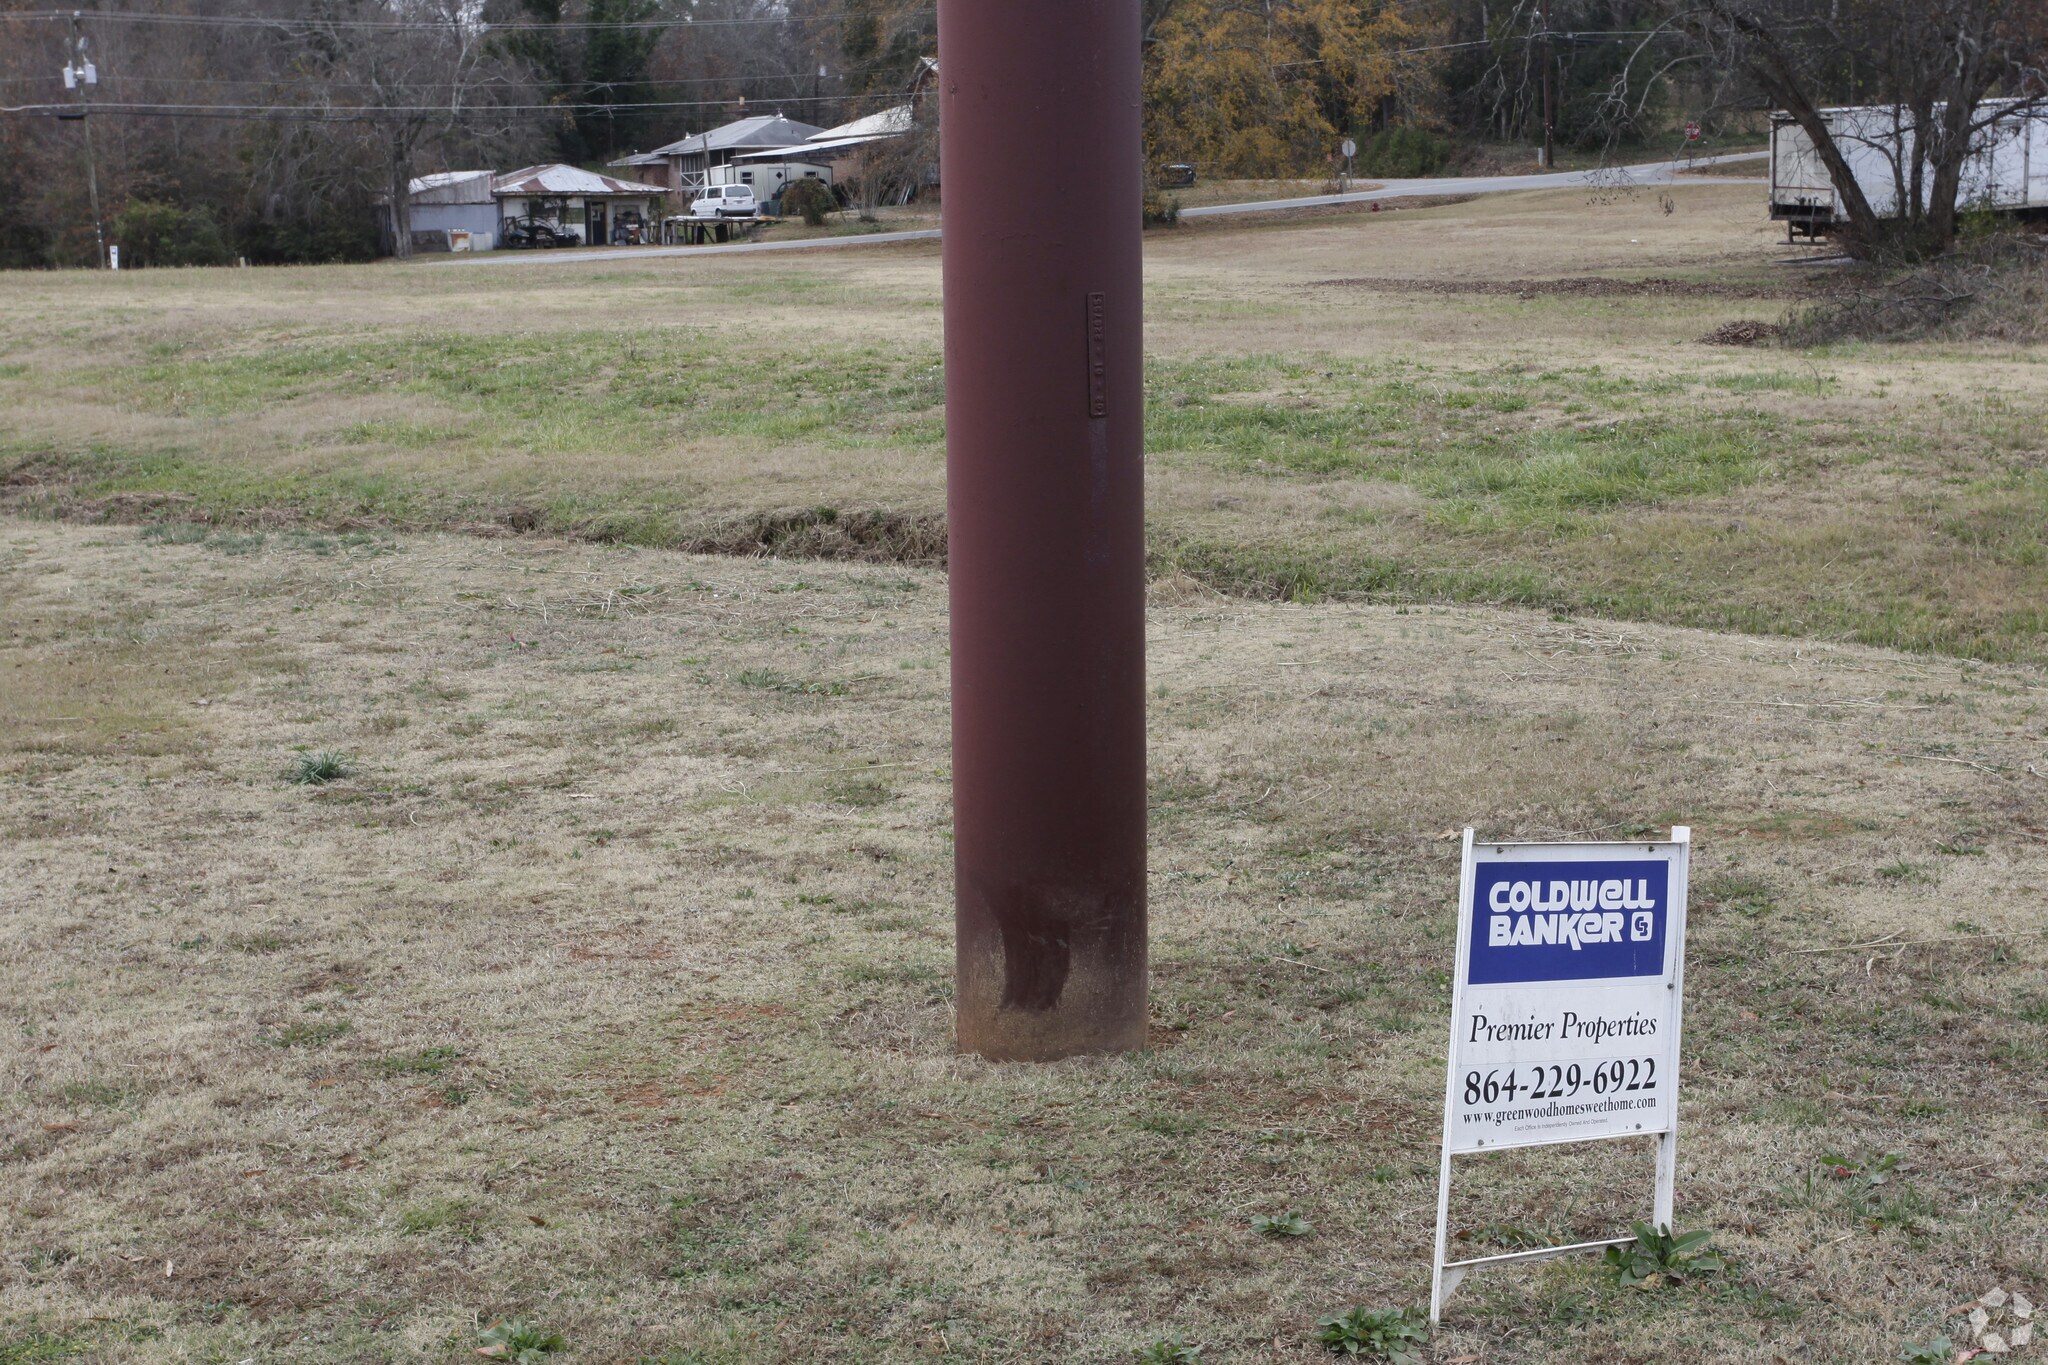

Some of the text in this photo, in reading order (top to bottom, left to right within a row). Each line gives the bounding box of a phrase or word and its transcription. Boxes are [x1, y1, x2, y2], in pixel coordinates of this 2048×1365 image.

[1489, 879, 1656, 913] COLDWELL
[1488, 912, 1625, 951] BANKER
[1469, 1011, 1657, 1044] Premier Properties
[1463, 1057, 1657, 1106] 864-229-6922
[1463, 1096, 1657, 1127] www.greenwoodhomesweethome.com
[1525, 1123, 1537, 1131] Office
